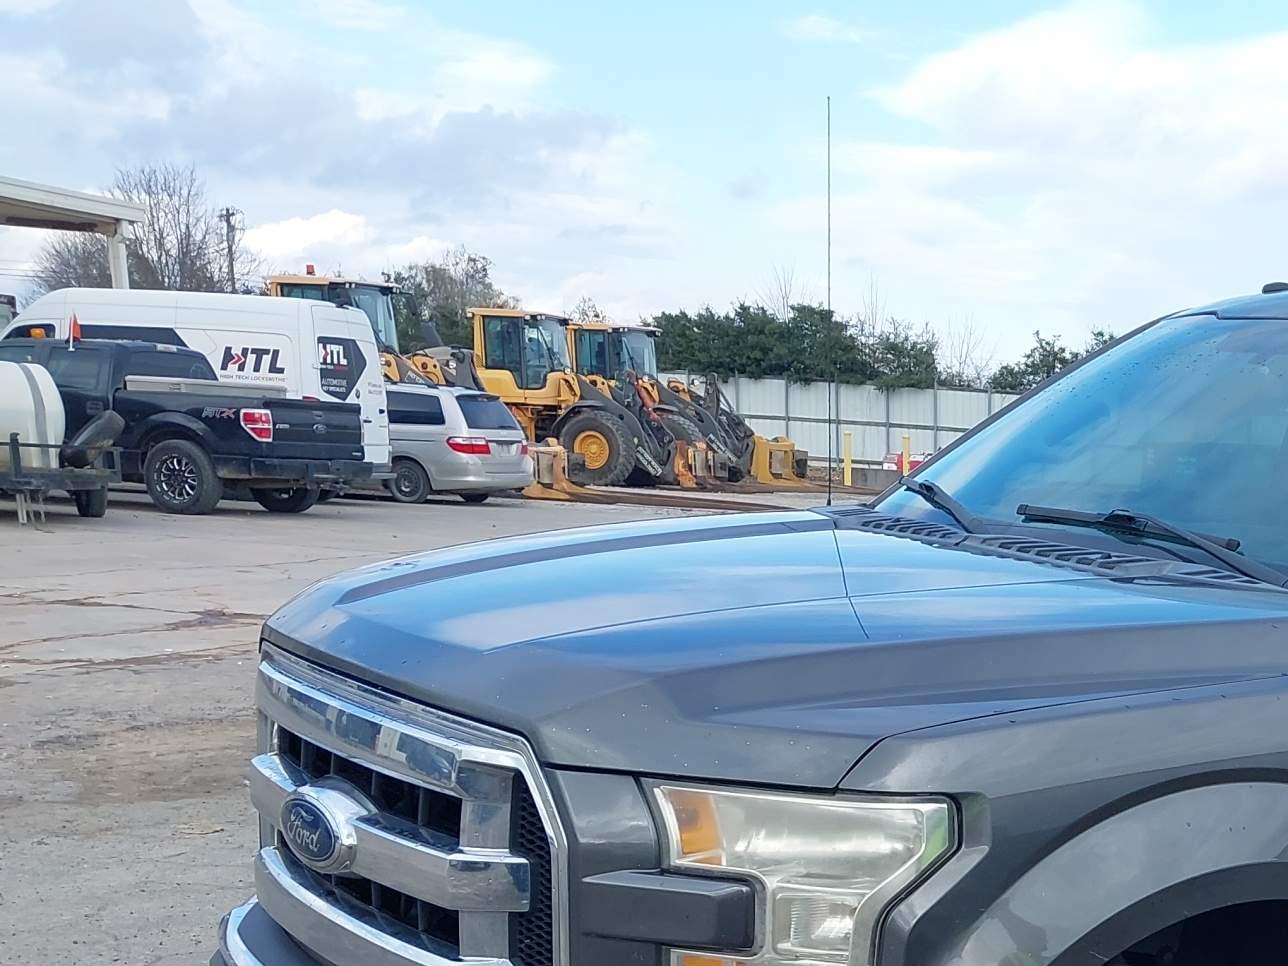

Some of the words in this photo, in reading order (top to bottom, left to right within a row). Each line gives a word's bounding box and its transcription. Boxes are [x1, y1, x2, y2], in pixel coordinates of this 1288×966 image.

[221, 346, 285, 374] HTL
[319, 343, 347, 365] HTL
[287, 806, 321, 852] Ford
